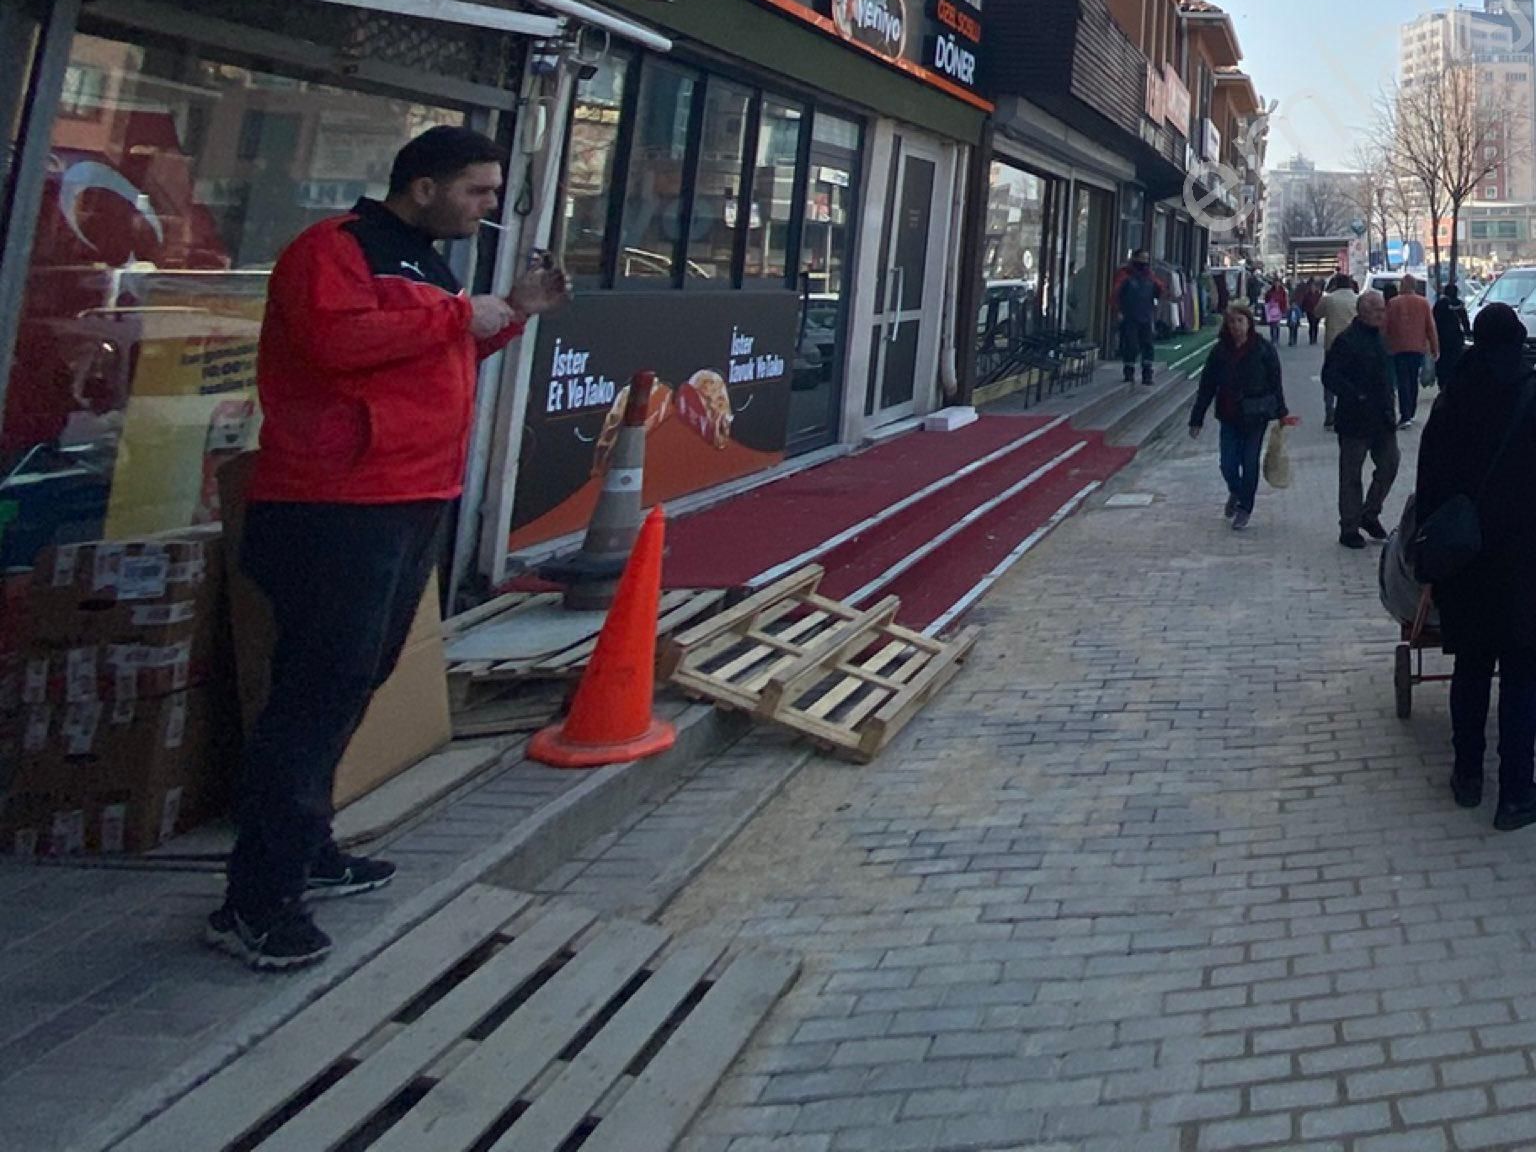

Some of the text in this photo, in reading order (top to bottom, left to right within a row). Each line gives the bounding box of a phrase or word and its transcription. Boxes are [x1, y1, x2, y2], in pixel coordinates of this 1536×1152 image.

[935, 33, 976, 86] DÖNER
[552, 338, 590, 377] İster
[547, 380, 563, 412] Et
